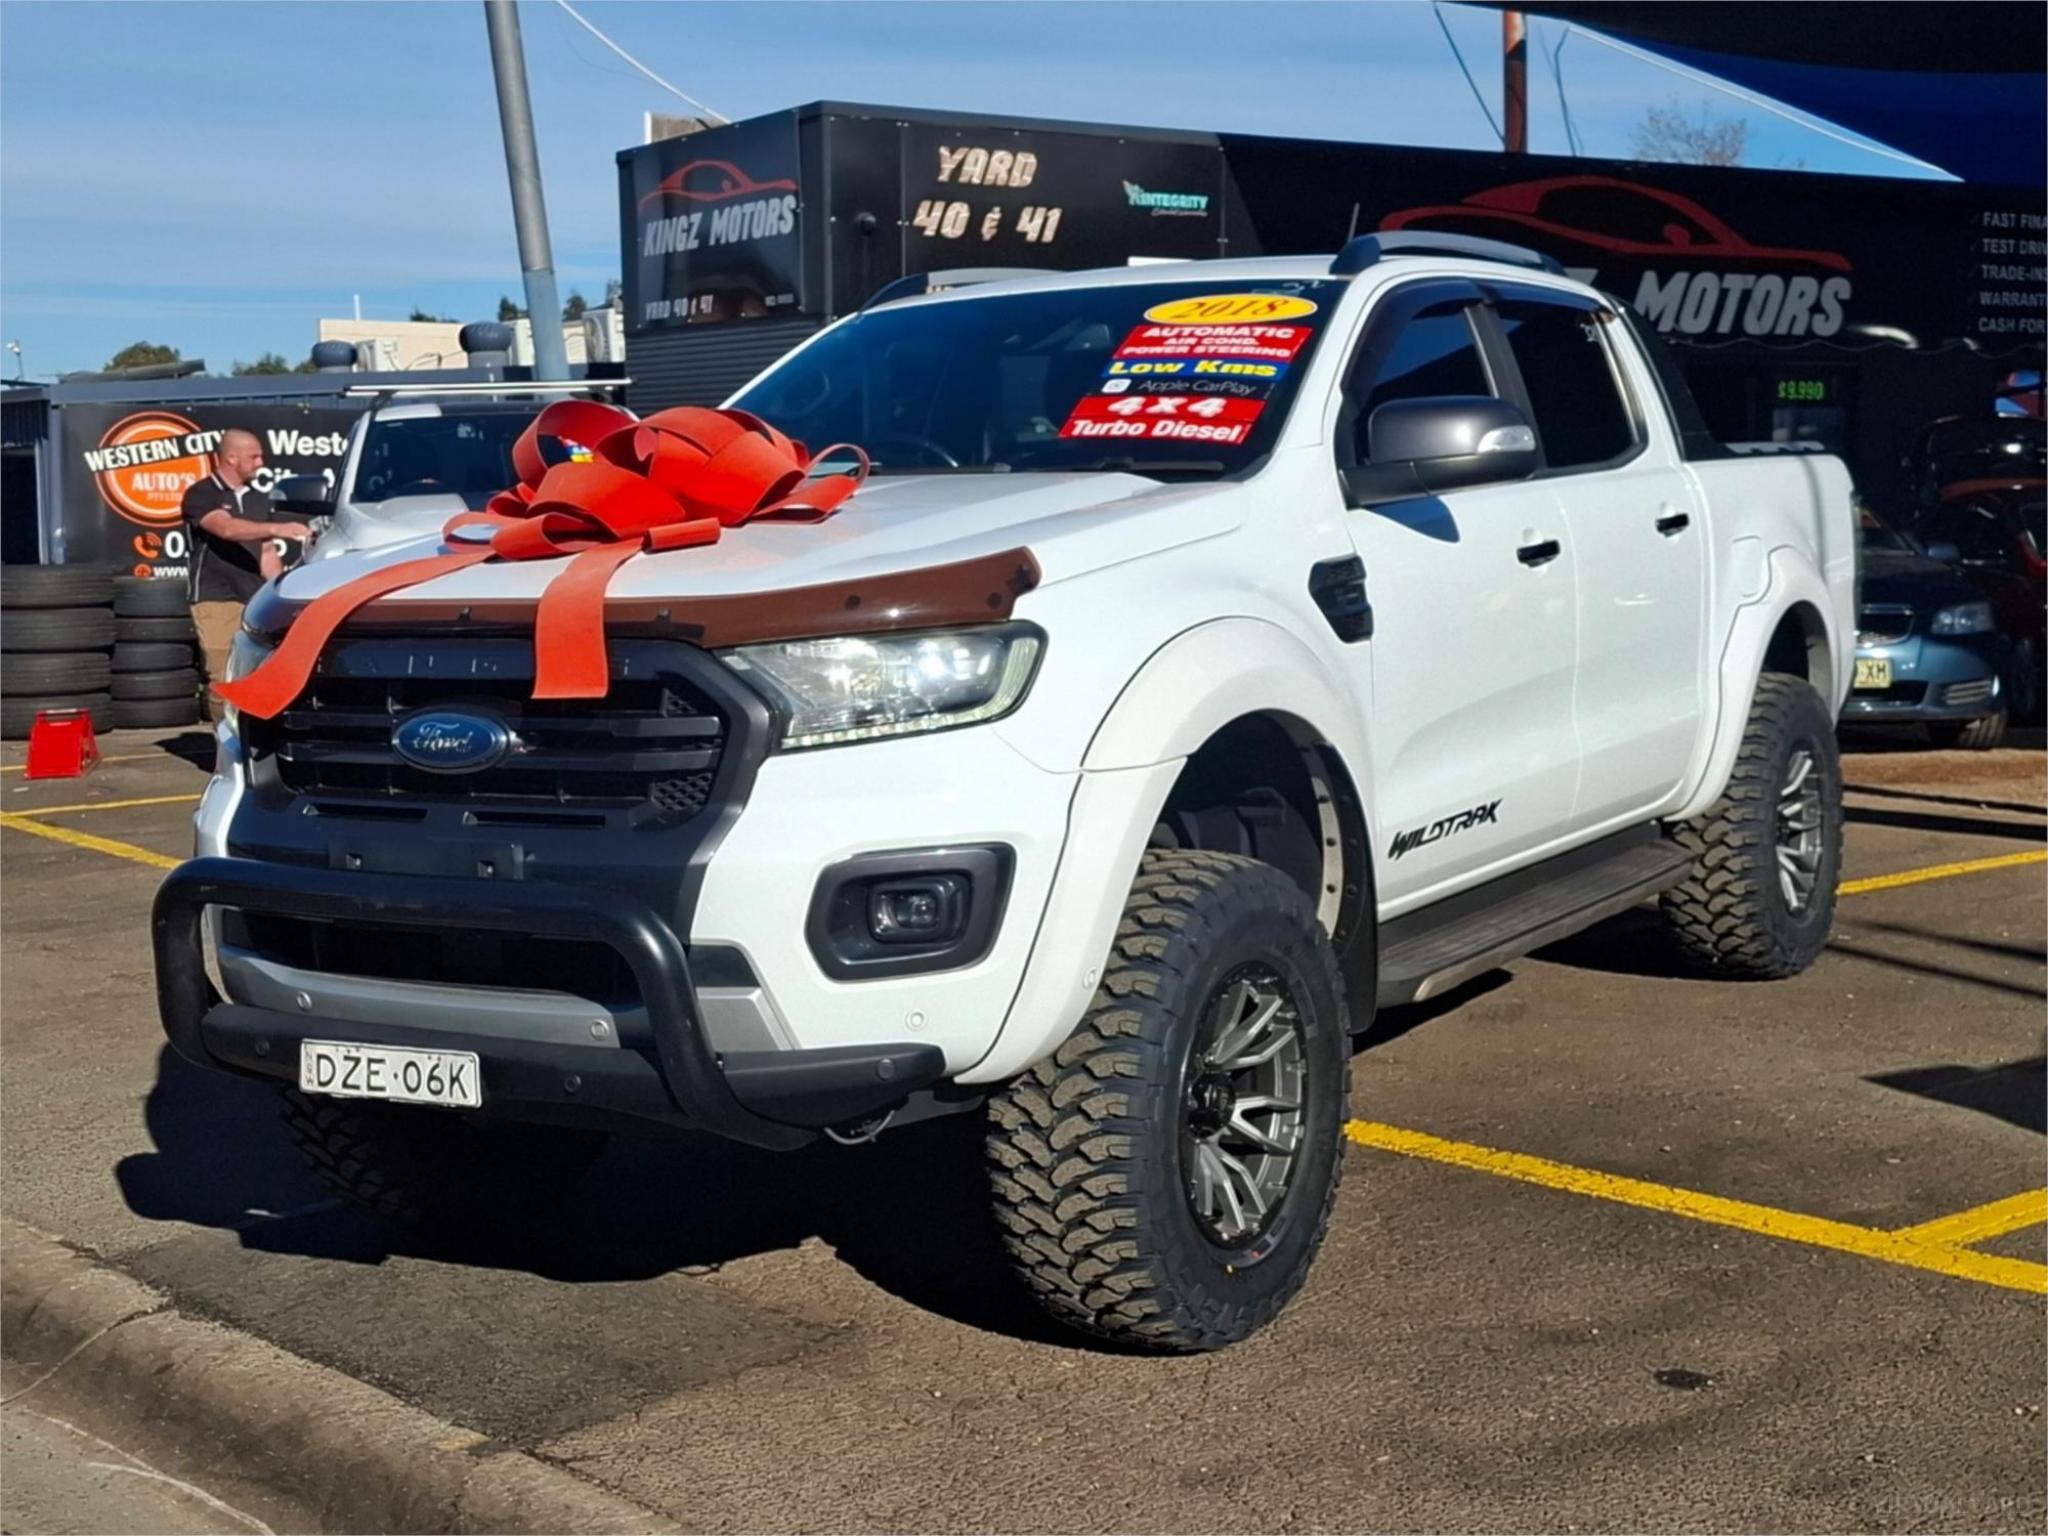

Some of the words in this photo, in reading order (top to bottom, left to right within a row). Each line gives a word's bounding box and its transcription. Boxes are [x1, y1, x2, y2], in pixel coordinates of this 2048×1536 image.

[937, 146, 1038, 188] YARD
[643, 212, 703, 257] KINGZ
[709, 194, 797, 246] MOTORS
[913, 199, 971, 239] 40
[1016, 206, 1063, 243] 41
[1982, 211, 2017, 228] FAST
[1981, 238, 2016, 254] TEST
[1172, 299, 1289, 319] 2018
[1633, 270, 1852, 337] MOTORS
[1142, 326, 1296, 339] AUTOMATIC
[1978, 317, 2016, 333] CASH
[2019, 318, 2046, 334] FOR
[1122, 345, 1190, 355] POWER
[1193, 346, 1292, 358] STEERING
[1163, 337, 1198, 345] AIR
[1201, 337, 1260, 346] COND.
[1108, 361, 1186, 375] Low
[1194, 360, 1278, 377] Kms
[1138, 379, 1190, 394] Apple
[1192, 380, 1257, 395] CarPlay
[1107, 396, 1147, 416] 4
[1187, 397, 1228, 418] 4
[1071, 419, 1147, 437] Turbo
[1151, 420, 1243, 442] Diesel
[84, 438, 180, 472] WESTERN
[411, 721, 474, 753] Ford
[1388, 799, 1503, 861] WILDTRAK
